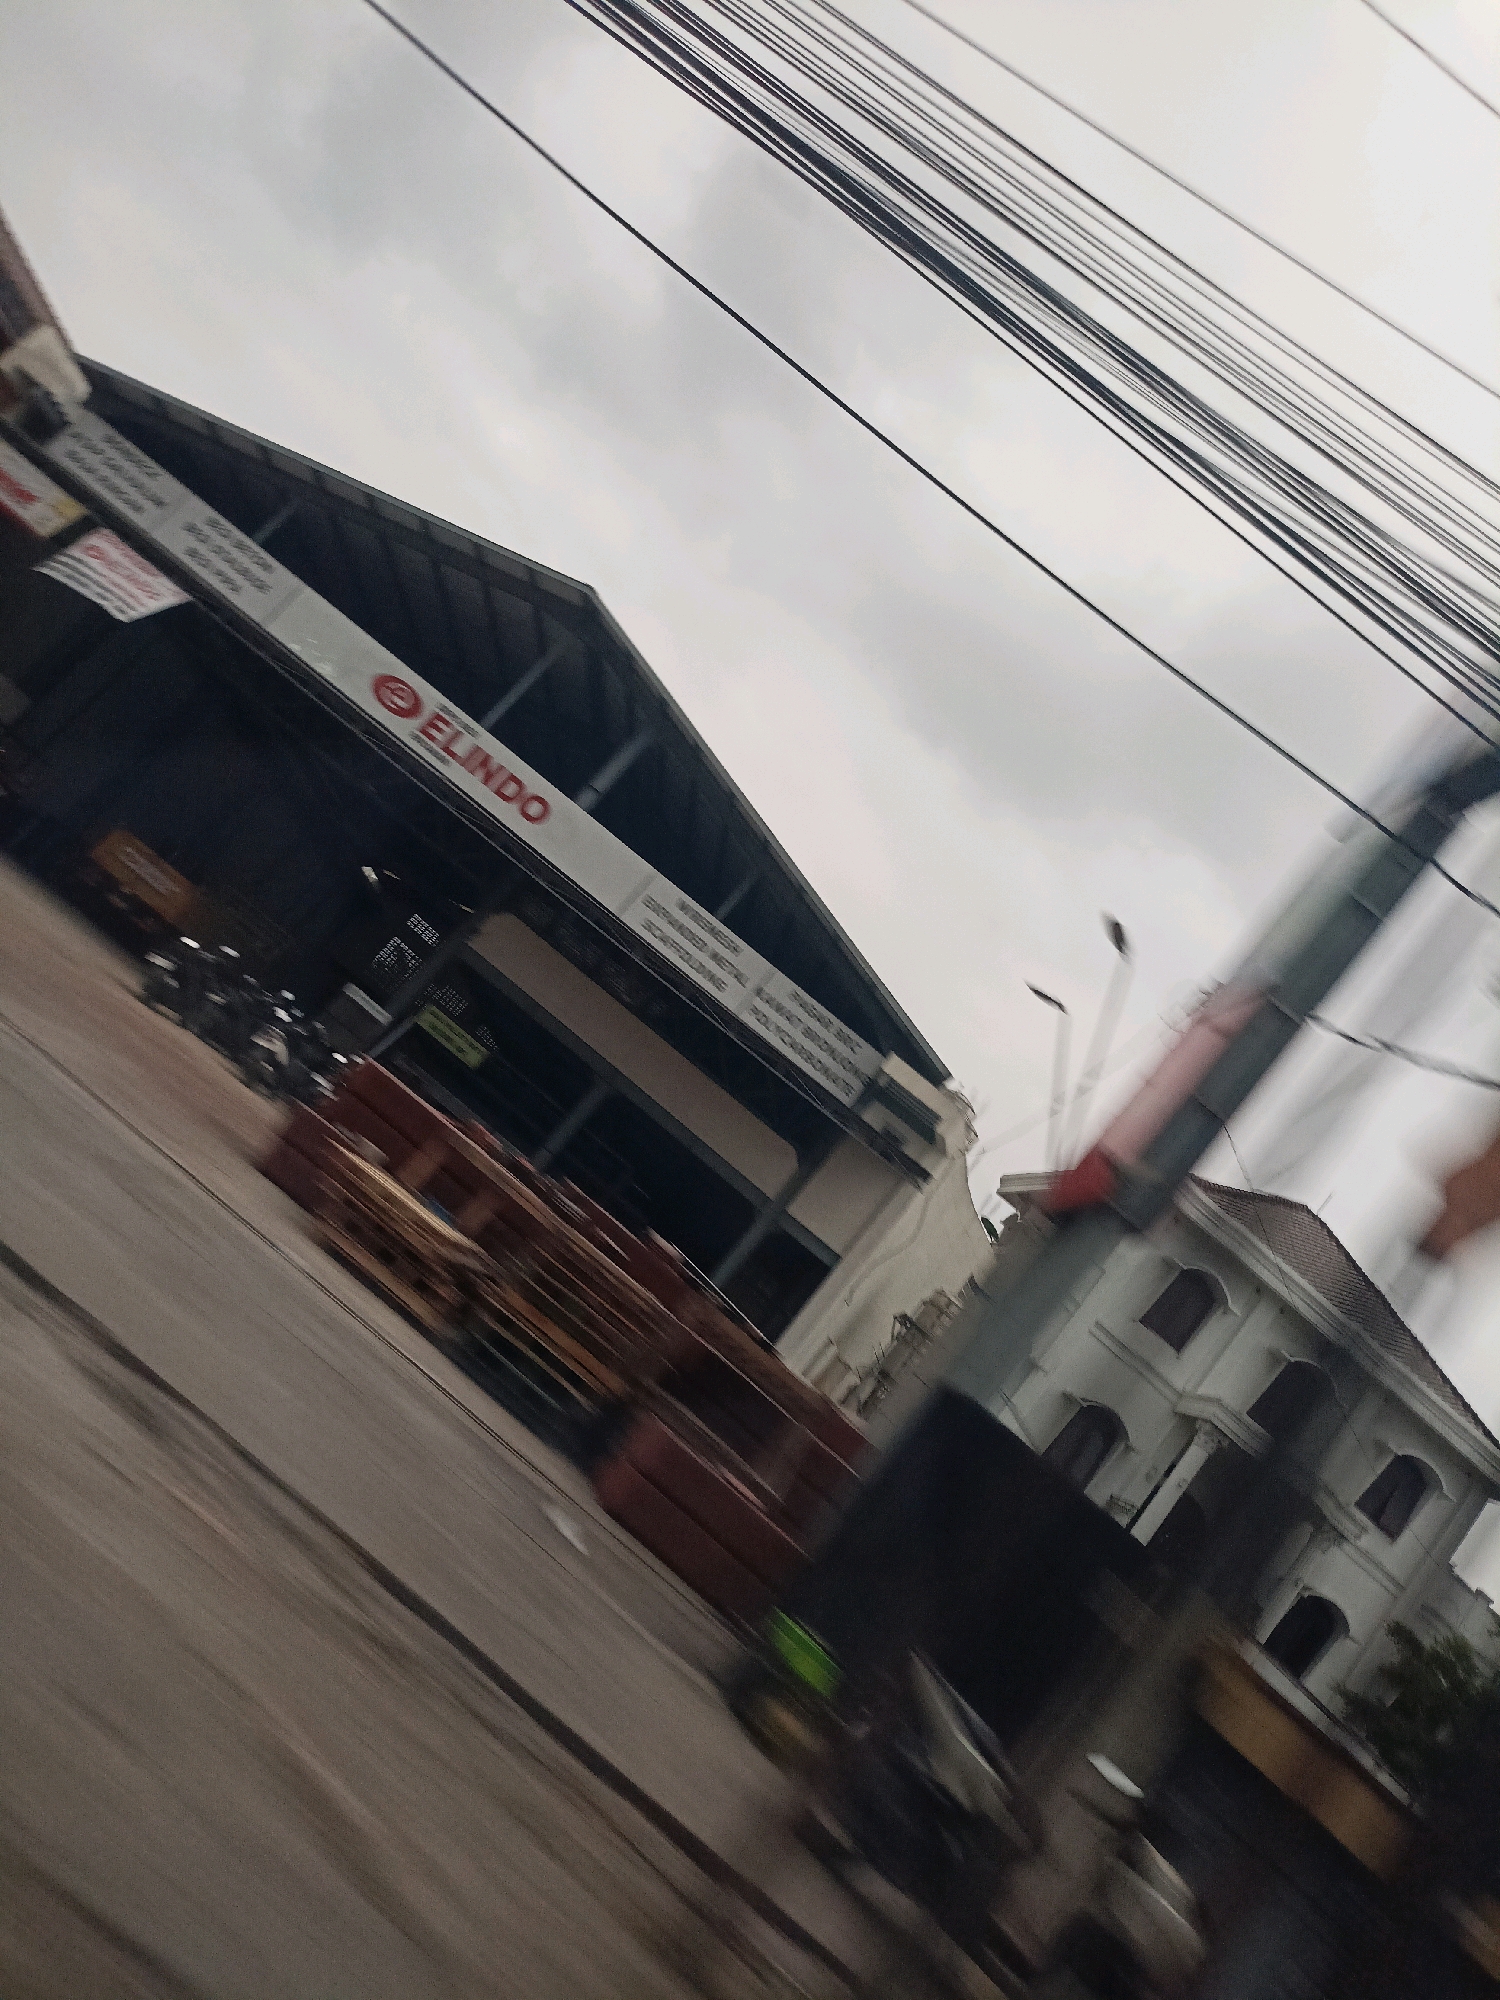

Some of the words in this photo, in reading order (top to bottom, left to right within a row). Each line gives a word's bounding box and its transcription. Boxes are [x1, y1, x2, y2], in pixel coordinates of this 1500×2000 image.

[418, 711, 550, 825] ELINDO
[639, 917, 729, 994] SCAFFOLDING
[640, 893, 709, 953] EXPANDED
[708, 950, 751, 987] METAL
[673, 897, 744, 958] WIREMESH
